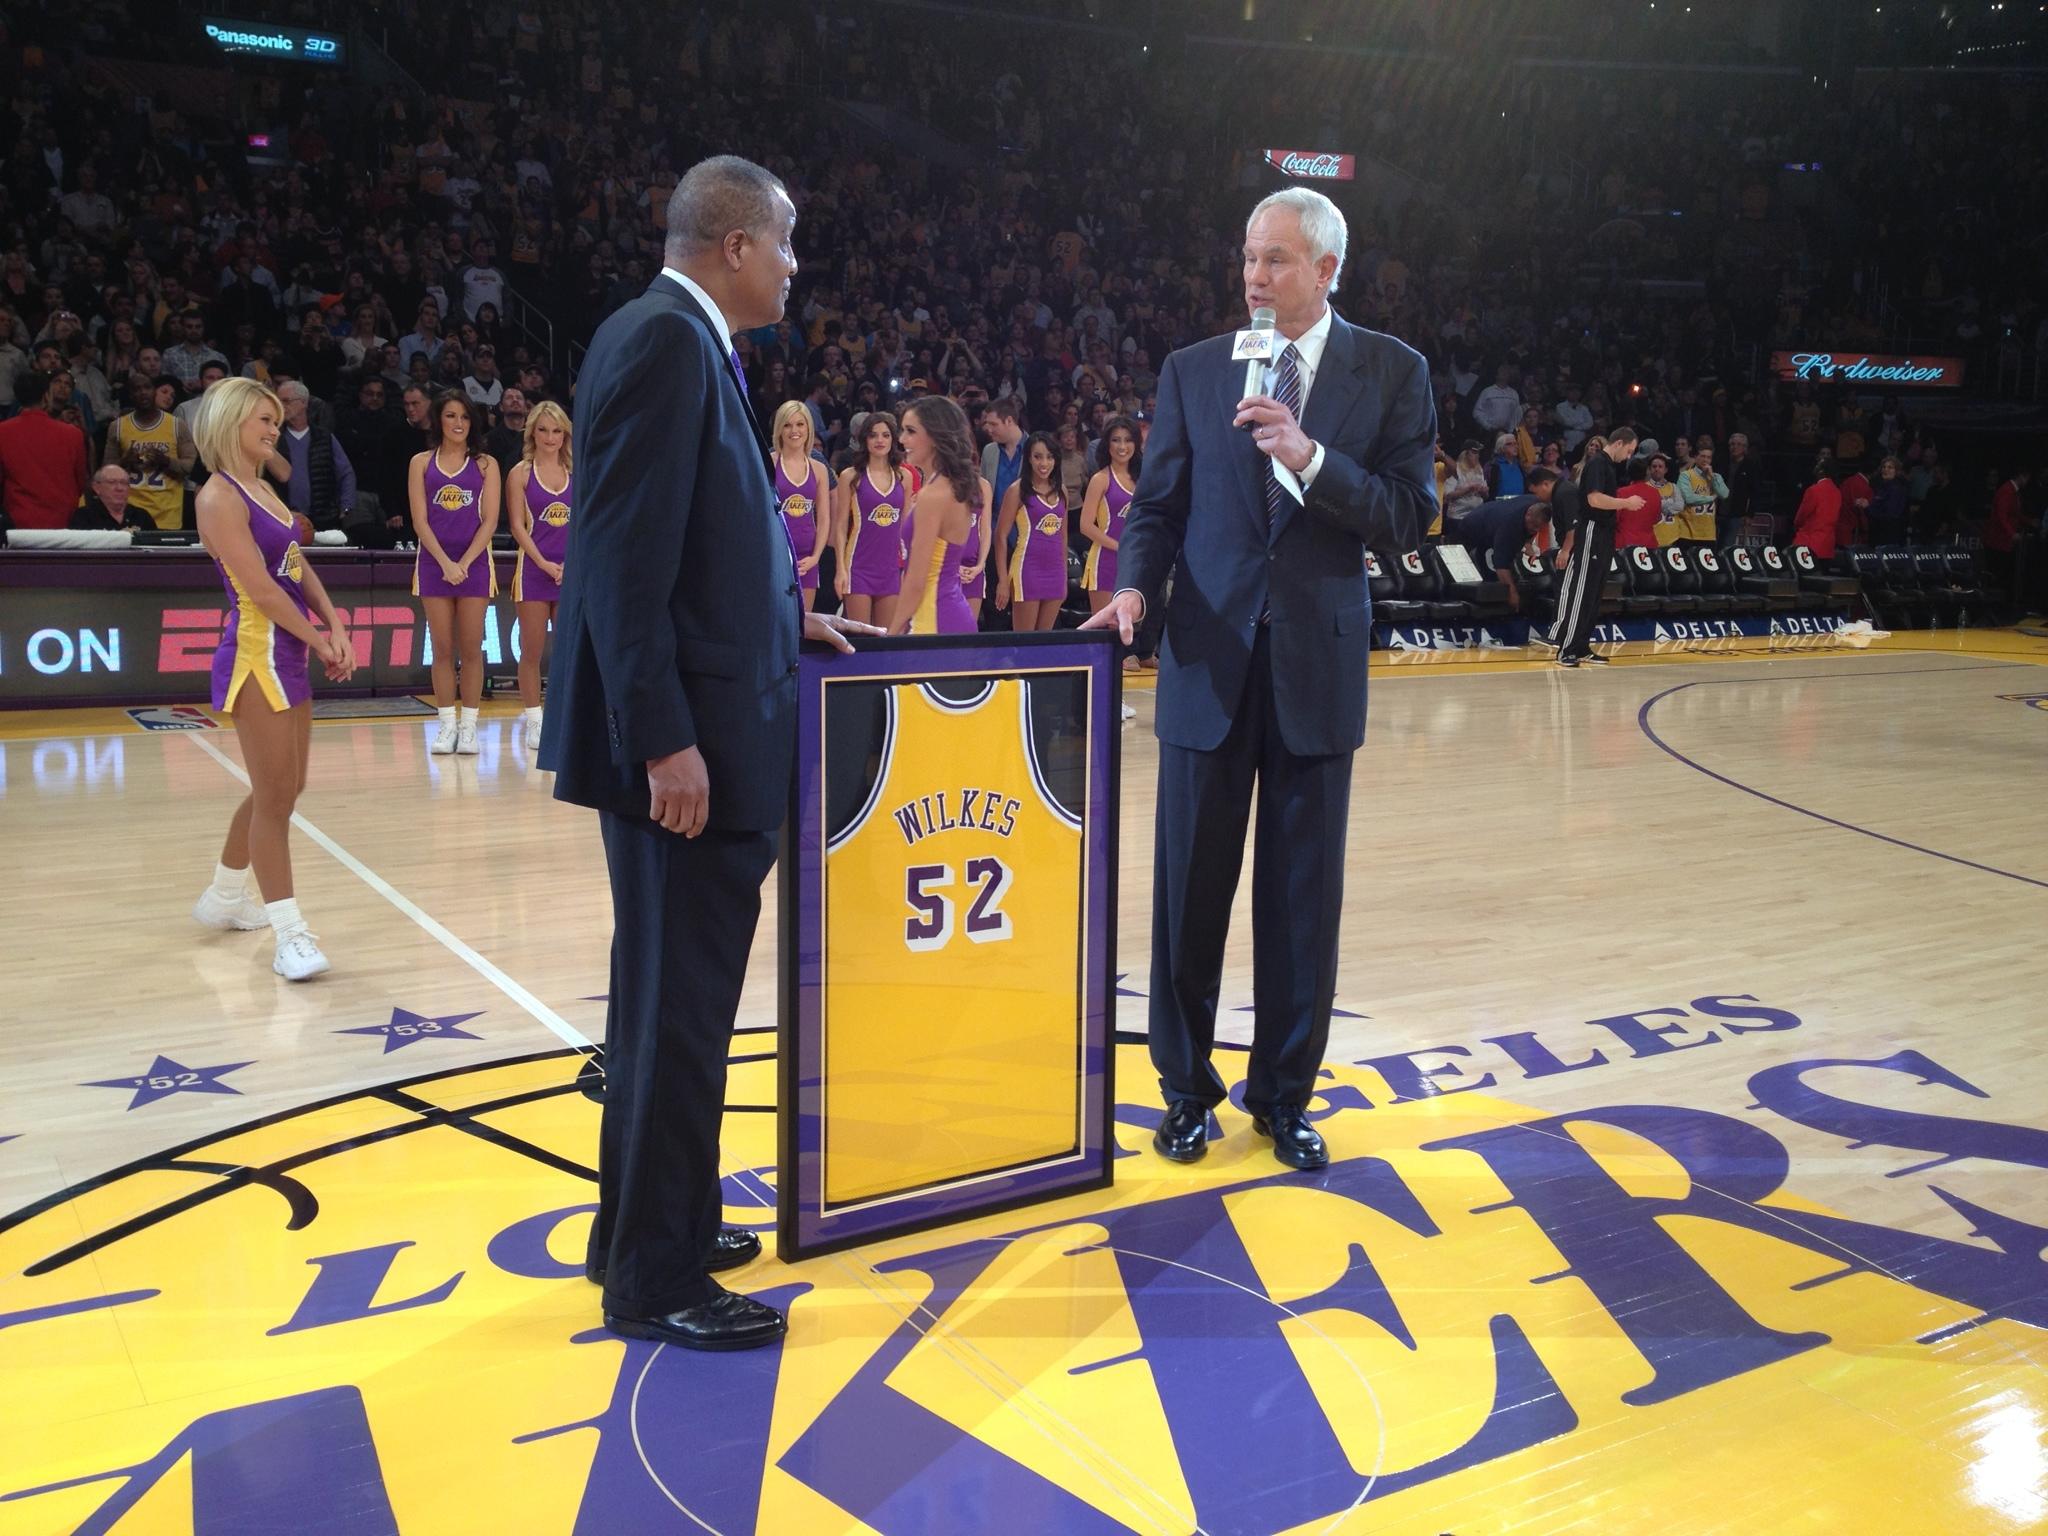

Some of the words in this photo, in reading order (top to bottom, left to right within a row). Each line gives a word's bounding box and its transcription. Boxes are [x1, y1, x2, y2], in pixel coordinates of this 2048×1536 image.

[205, 24, 293, 50] Panasonic
[304, 38, 336, 52] 3D
[434, 489, 473, 505] LAKERS
[781, 499, 813, 513] LAKERS
[868, 508, 900, 522] LAKERS
[1402, 550, 1425, 574] G
[1633, 547, 1653, 571] G
[1667, 547, 1688, 572] G
[1699, 548, 1720, 572] G
[1733, 548, 1753, 572] G
[1764, 546, 1783, 569] G
[1795, 546, 1815, 570] G
[1413, 627, 1494, 648] DELTA
[1673, 620, 1744, 639] DELTA
[1786, 616, 1847, 635] DELTA
[27, 628, 120, 674] ON
[894, 788, 1021, 846] WILKES
[904, 855, 1014, 952] 52
